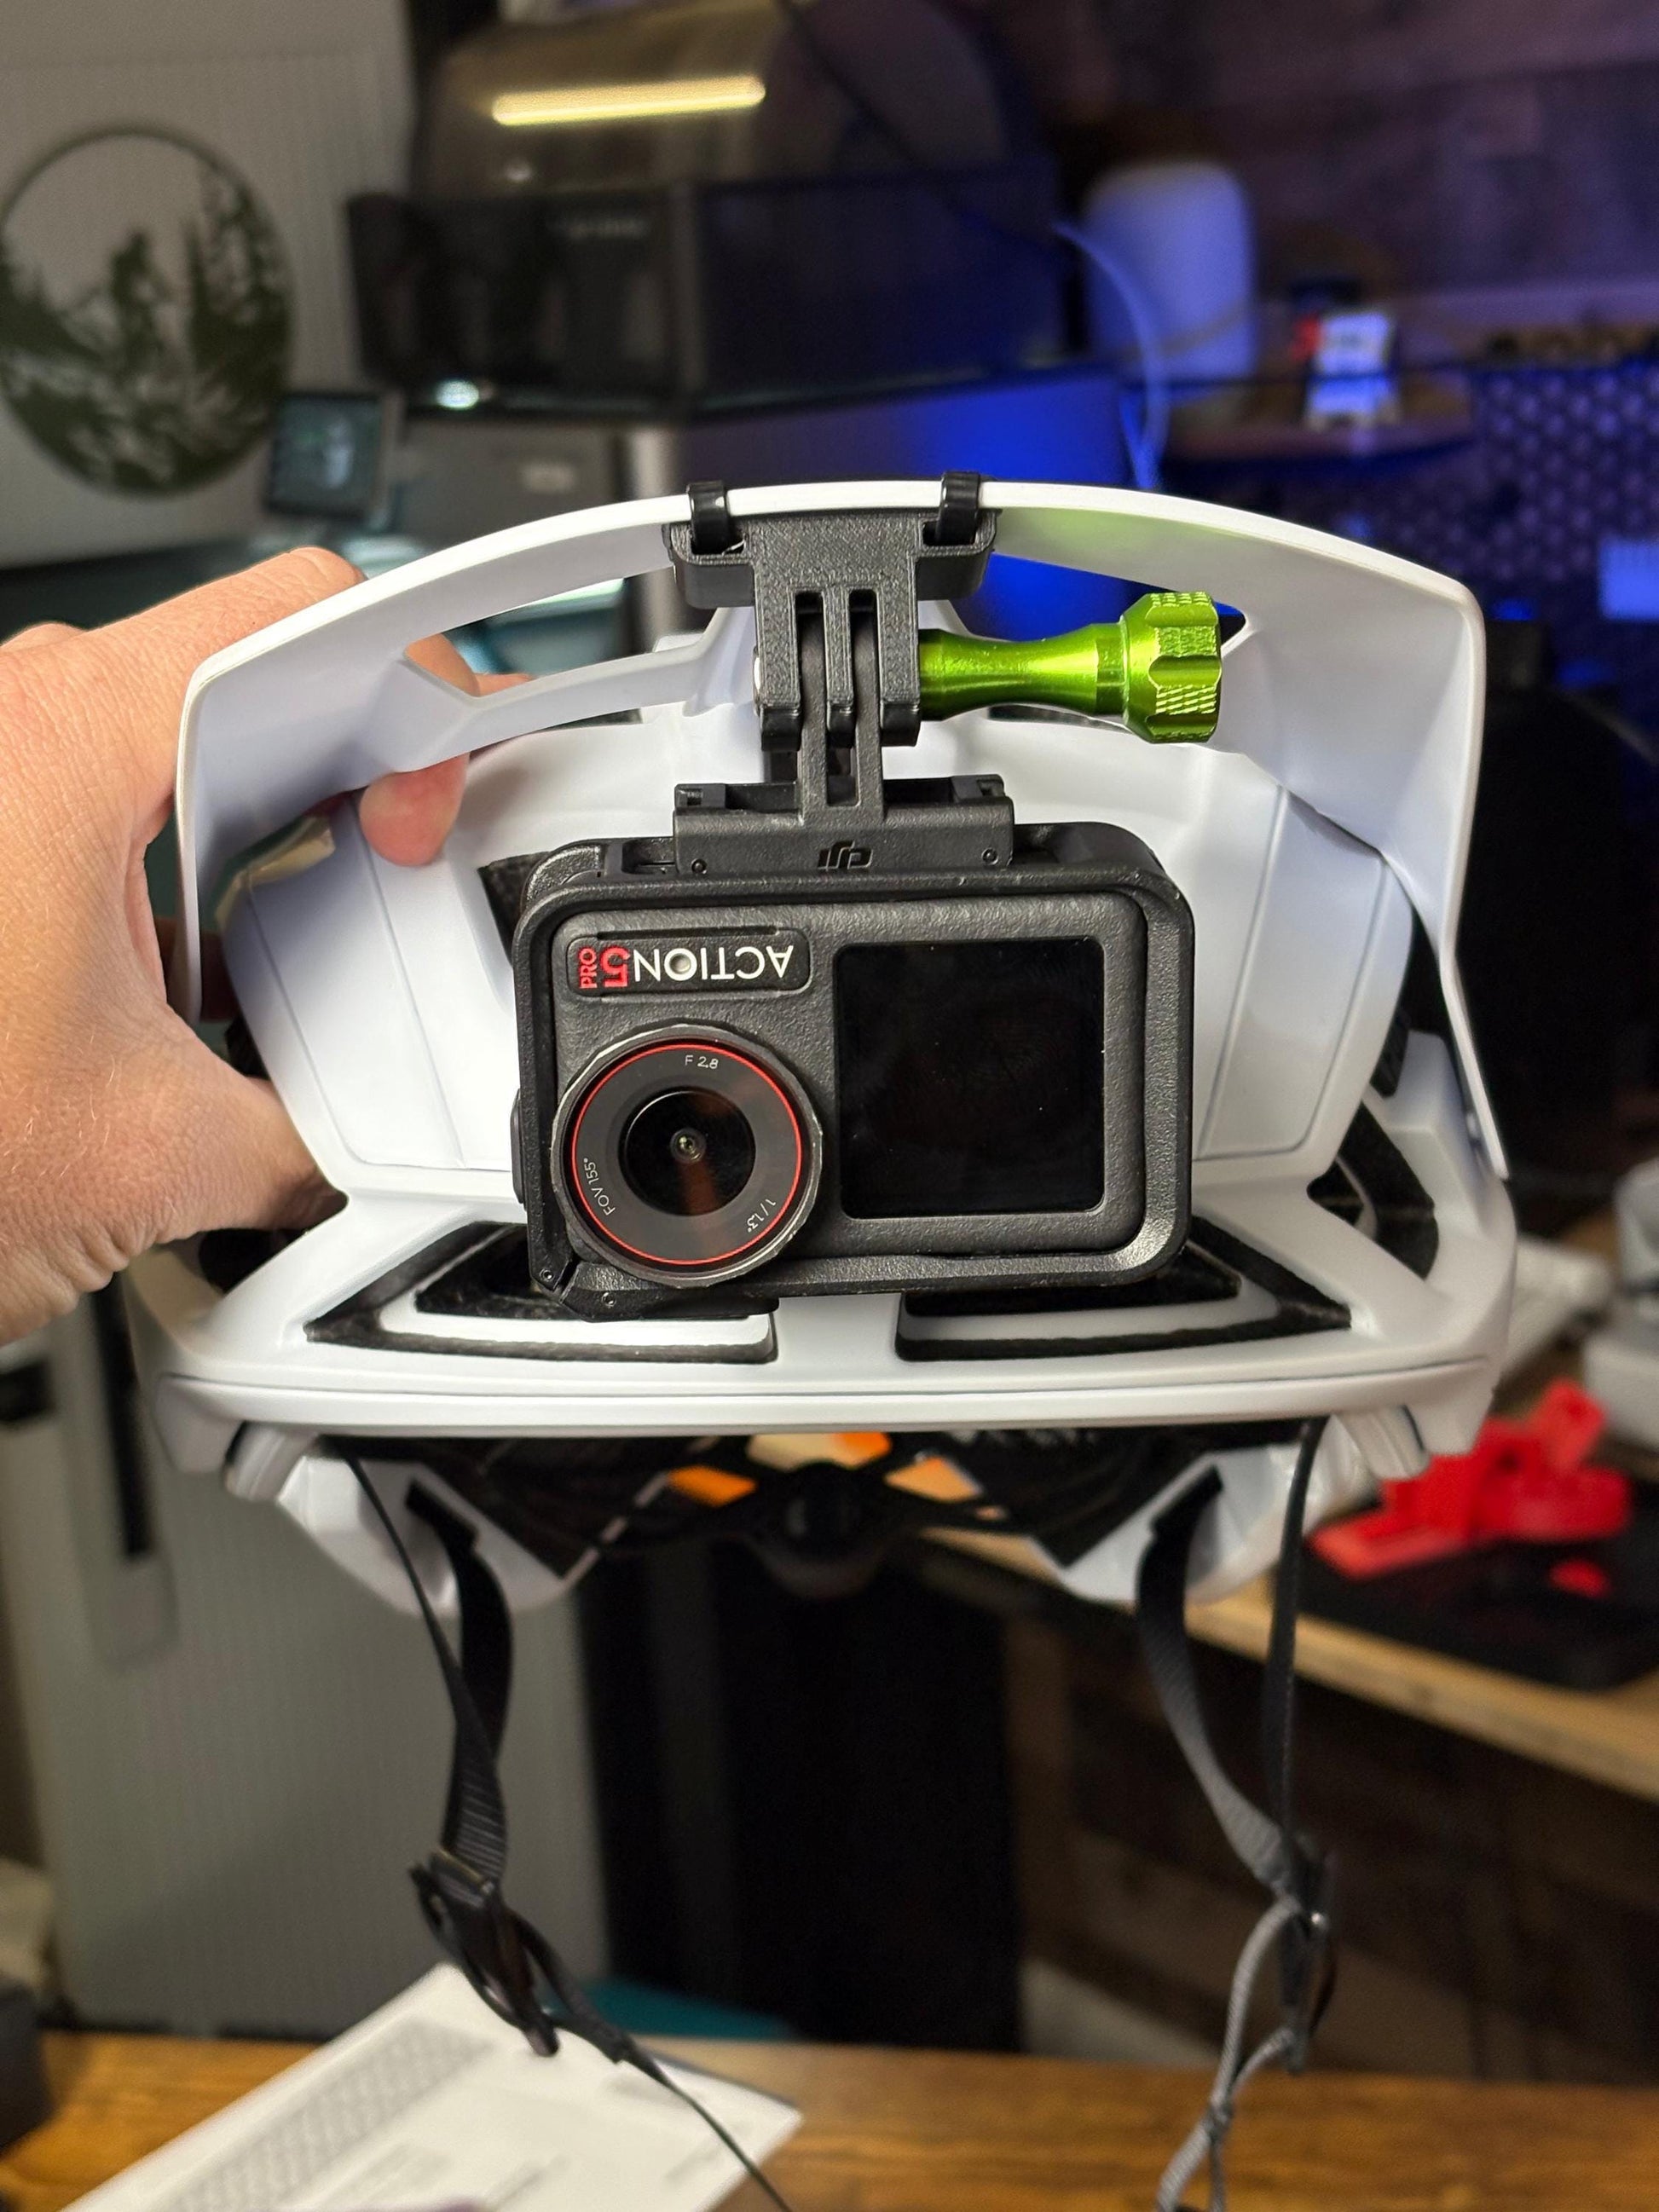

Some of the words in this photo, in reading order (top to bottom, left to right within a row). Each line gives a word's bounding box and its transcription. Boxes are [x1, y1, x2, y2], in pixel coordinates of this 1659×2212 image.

[578, 945, 598, 990] PRO
[599, 945, 631, 988] 5
[633, 944, 794, 983] ACTION
[697, 1055, 720, 1070] 2.8
[591, 1187, 616, 1216] FOV
